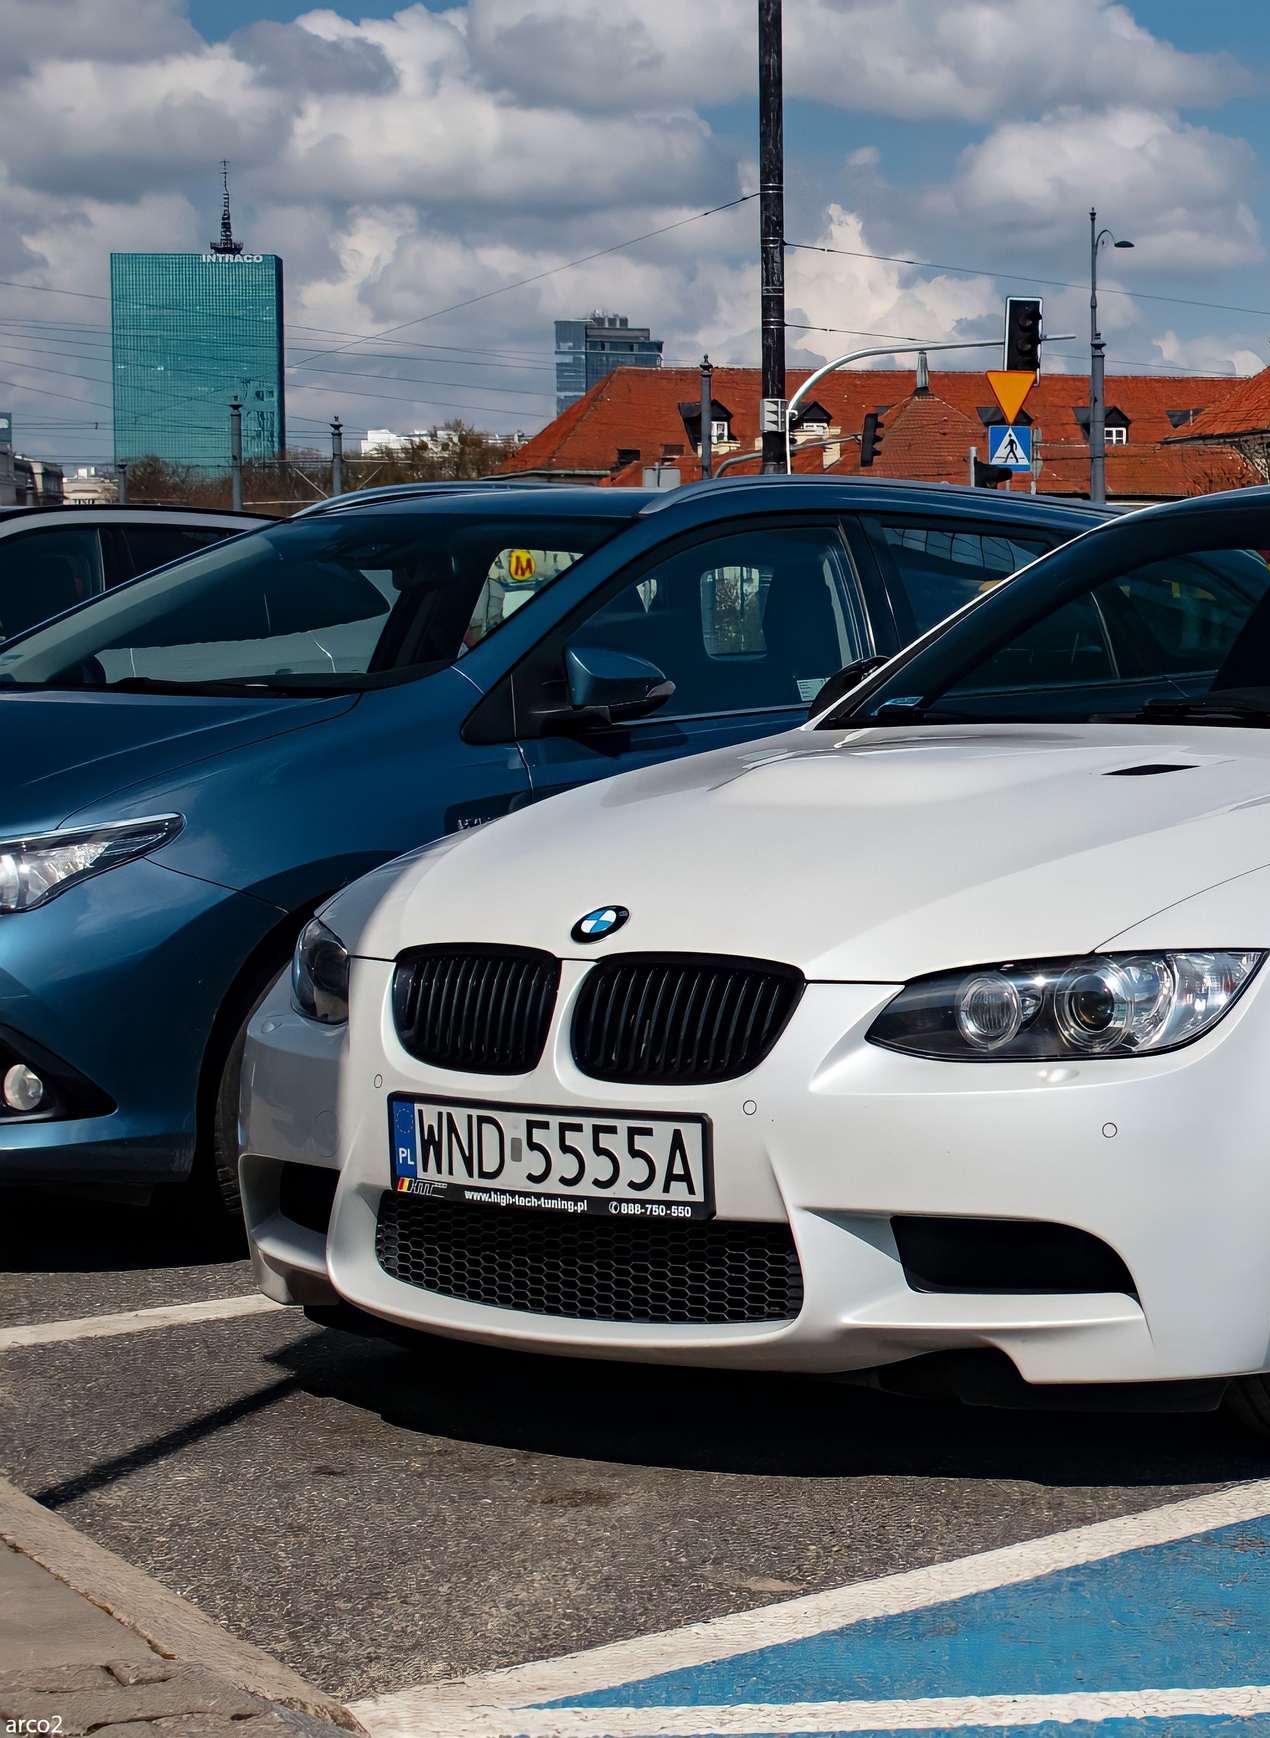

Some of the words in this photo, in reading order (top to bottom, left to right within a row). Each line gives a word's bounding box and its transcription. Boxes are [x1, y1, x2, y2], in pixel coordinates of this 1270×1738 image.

[202, 254, 263, 263] INTRACO
[514, 555, 533, 577] M
[398, 1147, 415, 1165] PL
[417, 1108, 506, 1180] WND
[525, 1118, 696, 1196] 5555A
[620, 1202, 692, 1218] 888-750-550
